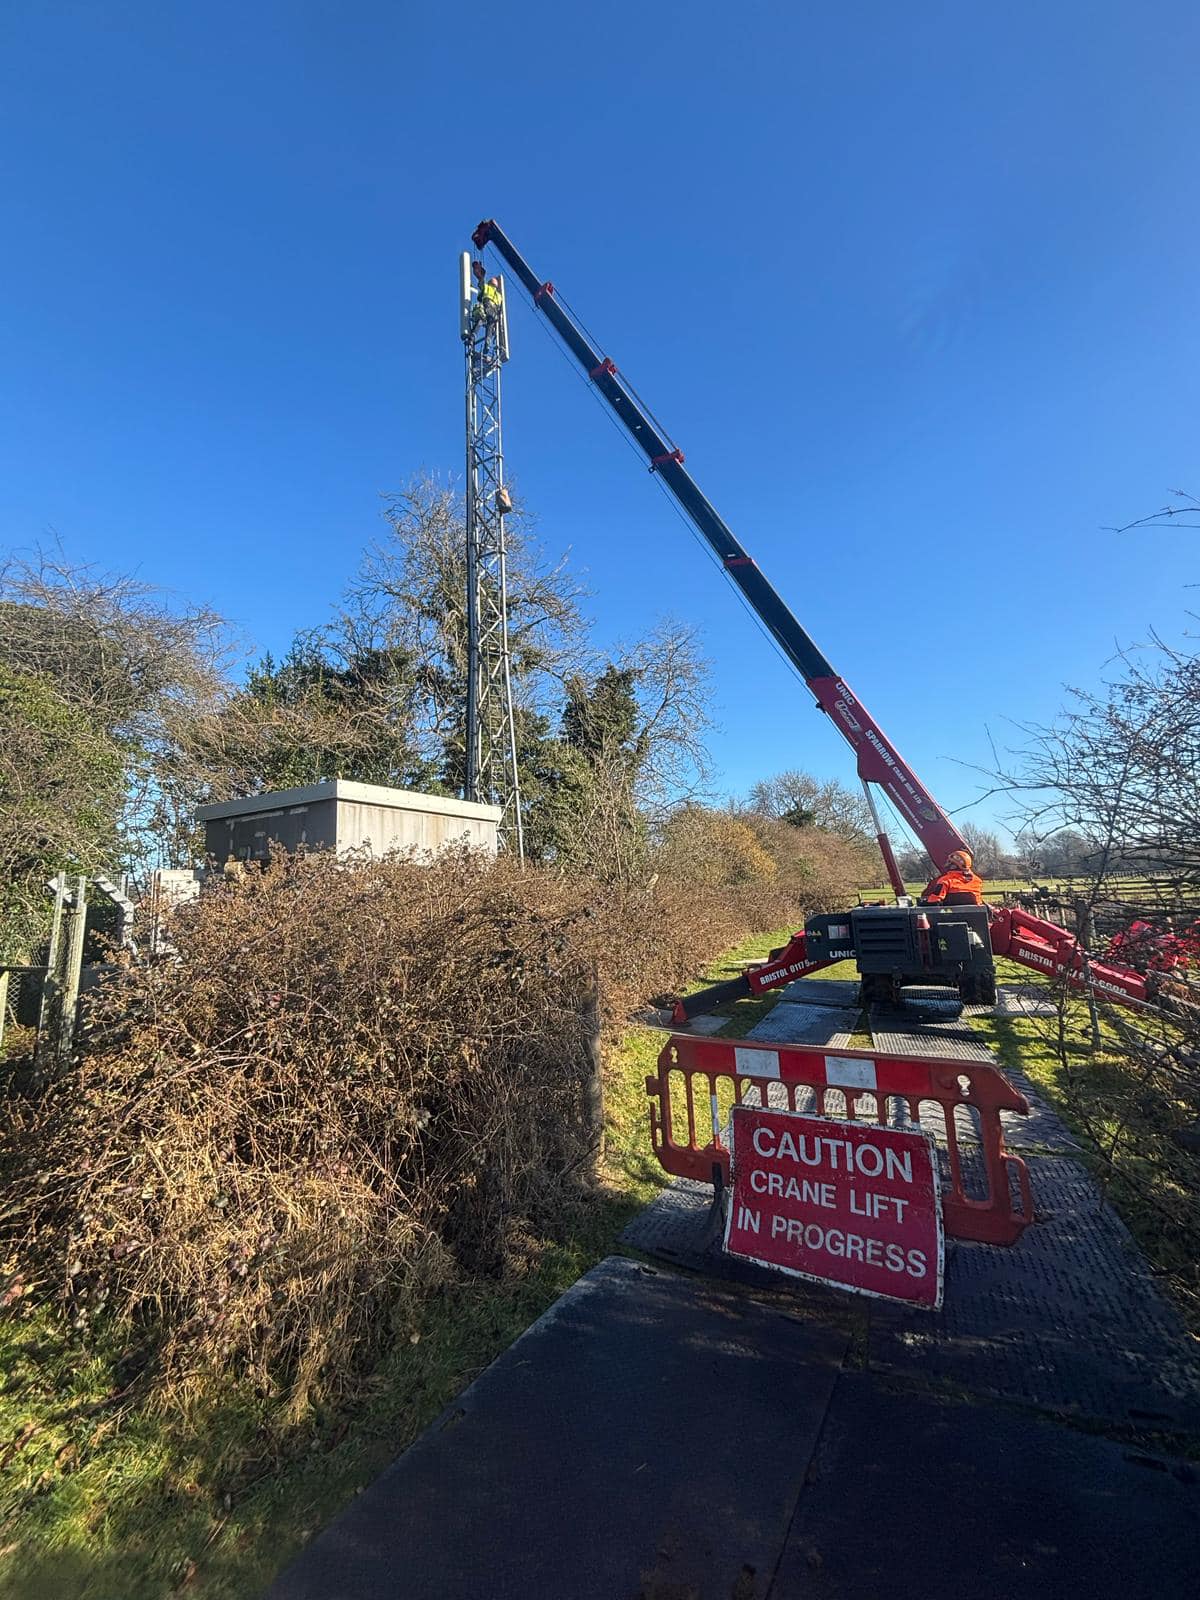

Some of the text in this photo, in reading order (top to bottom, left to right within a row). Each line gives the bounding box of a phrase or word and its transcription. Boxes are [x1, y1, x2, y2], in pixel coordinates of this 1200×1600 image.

[835, 682, 855, 706] UNIC
[865, 729, 895, 767] SPARROW
[829, 949, 857, 959] UNIC
[1018, 948, 1054, 968] BRISTOL
[759, 969, 788, 985] BRISTOL
[789, 961, 805, 974] 0117
[752, 1127, 913, 1183] CAUTION
[750, 1169, 909, 1224] CRANE LIFT
[737, 1207, 927, 1278] IN PROGRESS
